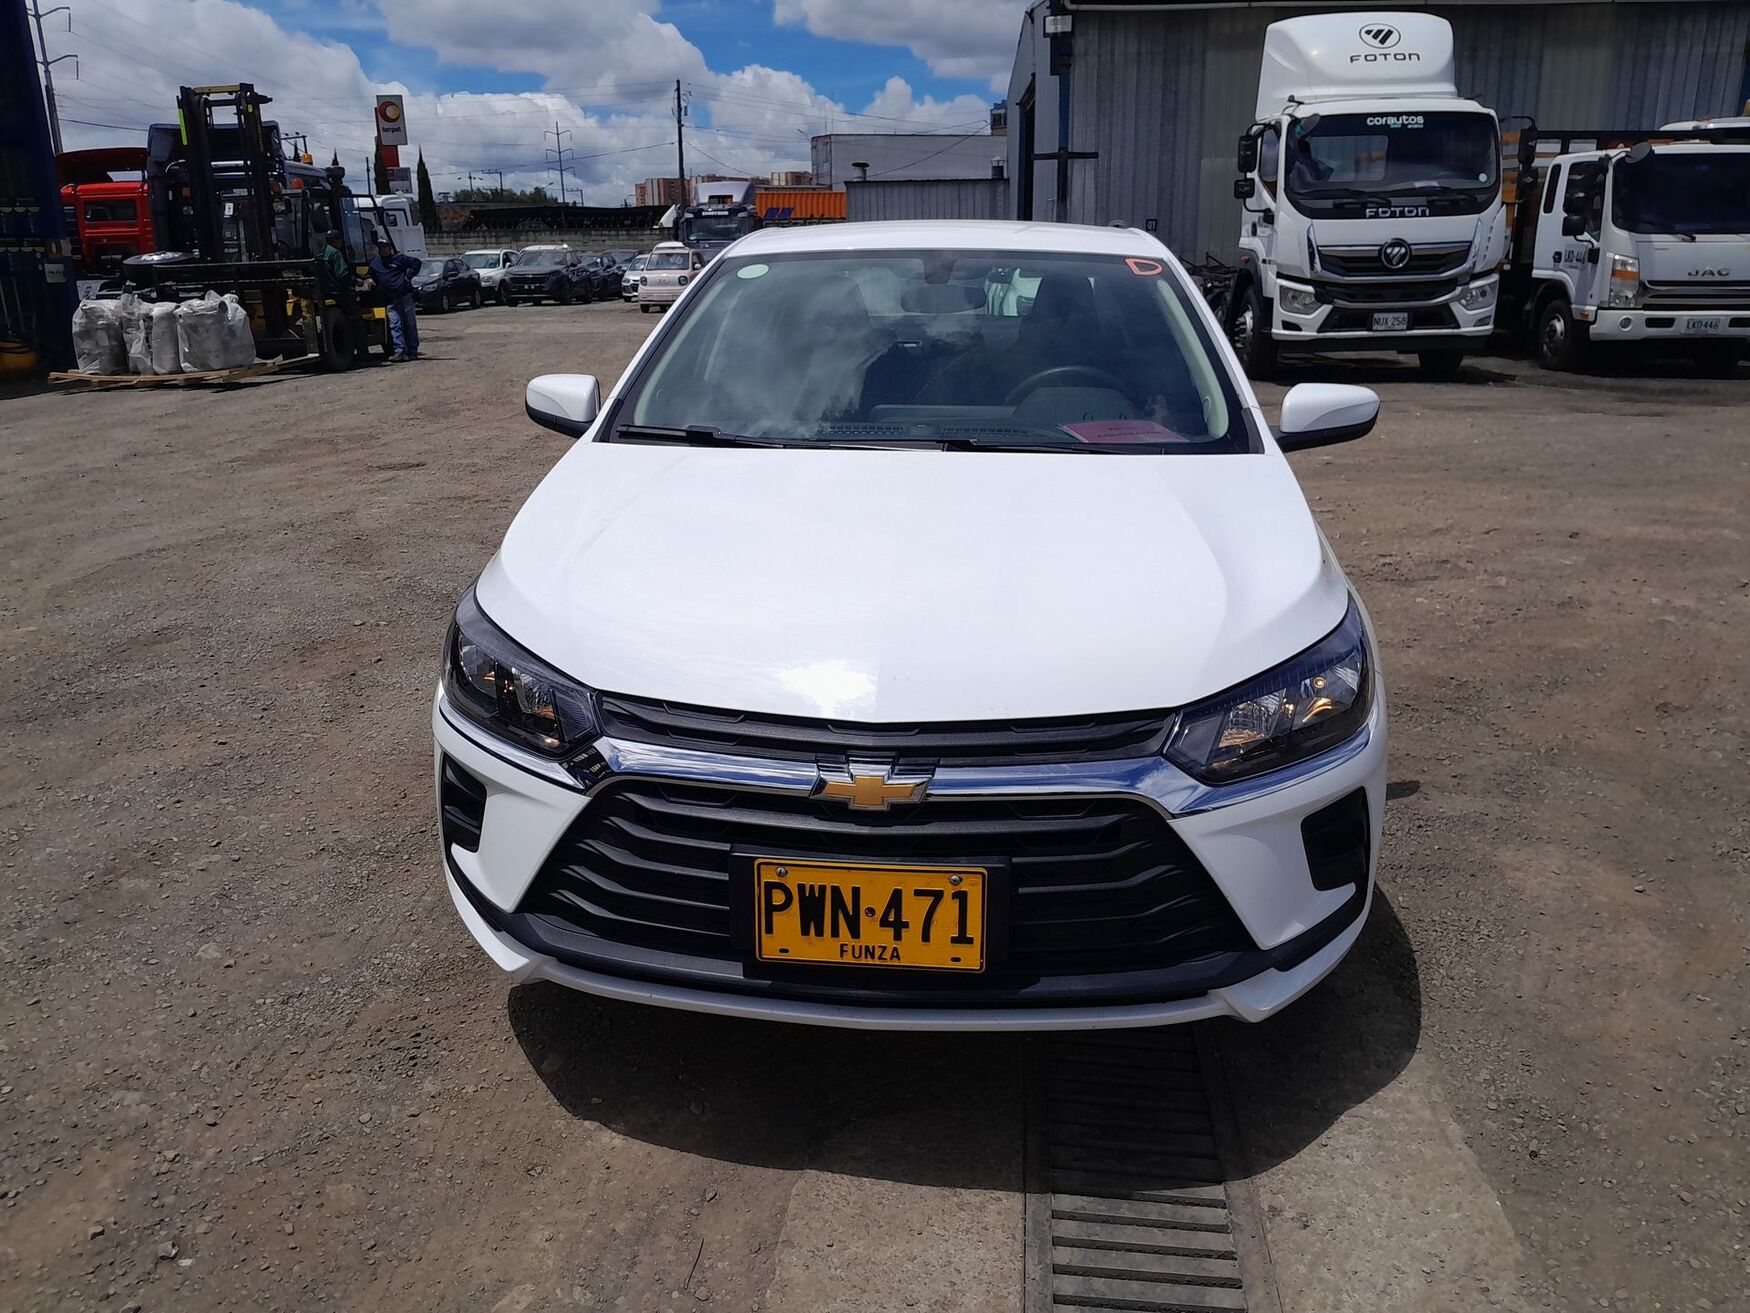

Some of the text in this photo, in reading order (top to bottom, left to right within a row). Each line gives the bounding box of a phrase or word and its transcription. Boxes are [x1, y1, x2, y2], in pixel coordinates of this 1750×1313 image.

[1349, 52, 1421, 63] FOTON
[1366, 115, 1424, 125] corautos
[1365, 206, 1430, 218] FOTON
[1687, 268, 1730, 277] JAC
[839, 943, 901, 962] FUNZA
